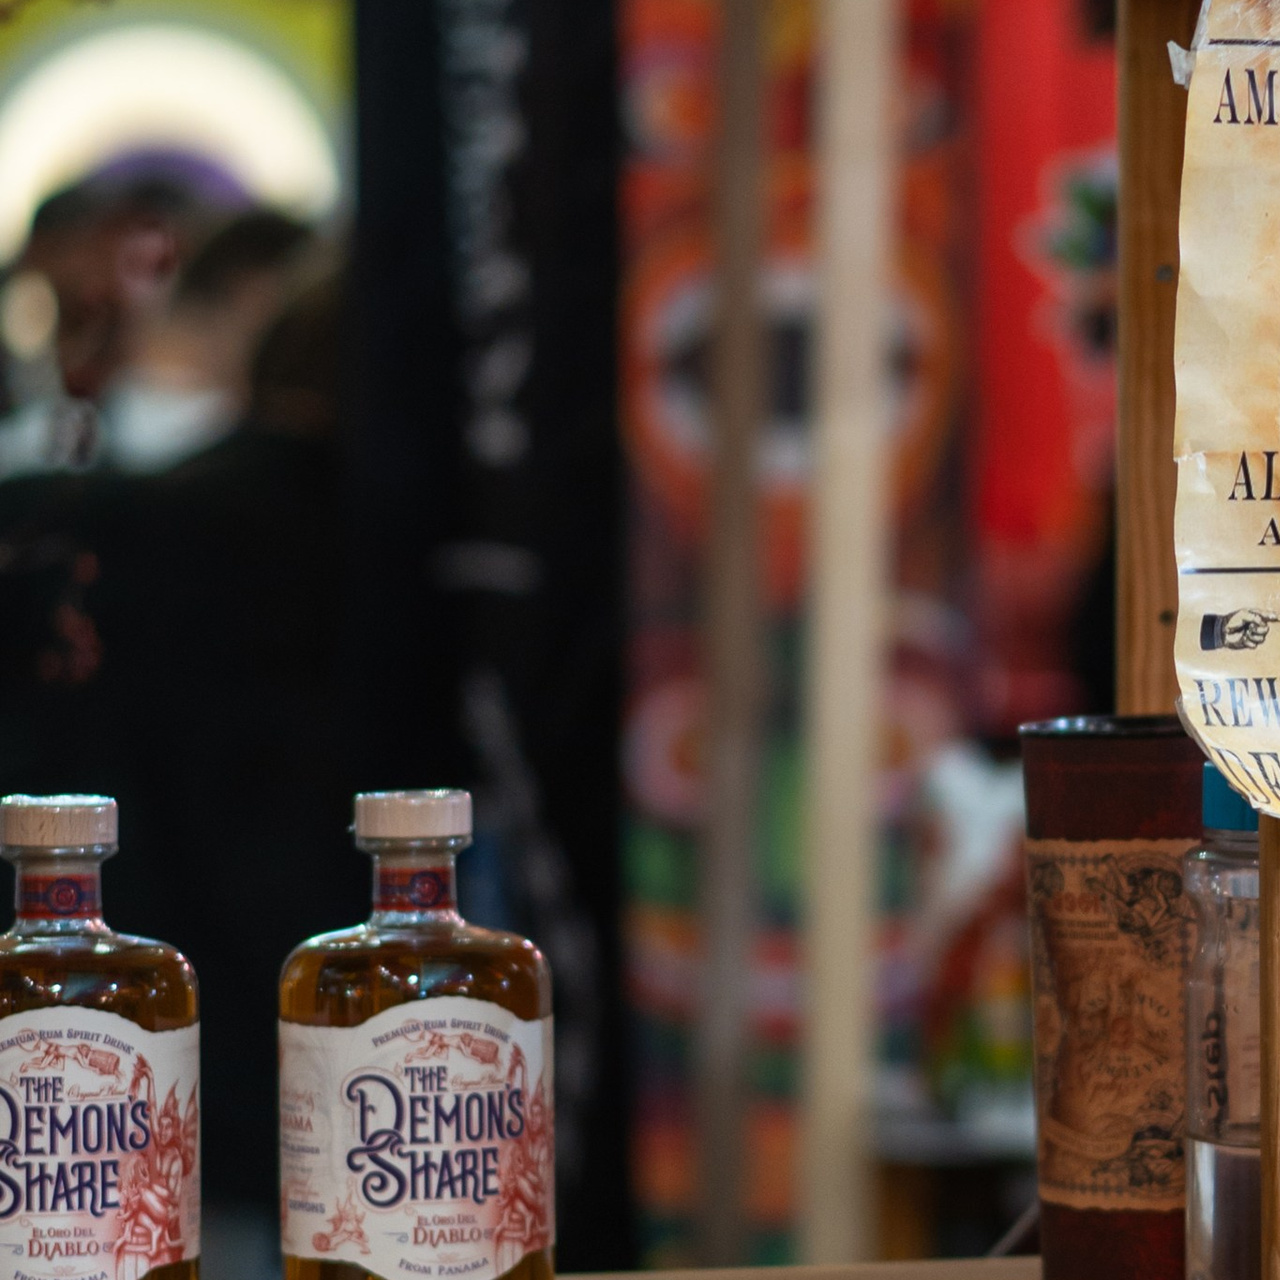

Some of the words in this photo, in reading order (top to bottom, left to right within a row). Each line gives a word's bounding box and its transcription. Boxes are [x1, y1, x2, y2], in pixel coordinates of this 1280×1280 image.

[39, 1028, 63, 1040] RUM
[66, 1028, 102, 1043] SPIRIT
[103, 1033, 134, 1055] DRINK
[371, 1021, 422, 1048] PREMIUM
[423, 1019, 447, 1031] RUM
[450, 1018, 482, 1032] SPIRIT
[484, 1023, 511, 1044] DRINK
[20, 1076, 65, 1103] THE
[404, 1065, 448, 1092] THE
[346, 1073, 525, 1147] DEMON'S
[346, 1131, 500, 1209] SHARE
[32, 1227, 47, 1238] EL
[47, 1227, 71, 1237] ORO
[73, 1226, 95, 1237] DEL
[413, 1226, 482, 1249] DIABLO
[28, 1239, 100, 1261] DIABLO
[398, 1257, 433, 1276] FROM
[438, 1257, 489, 1276] PANAMA
